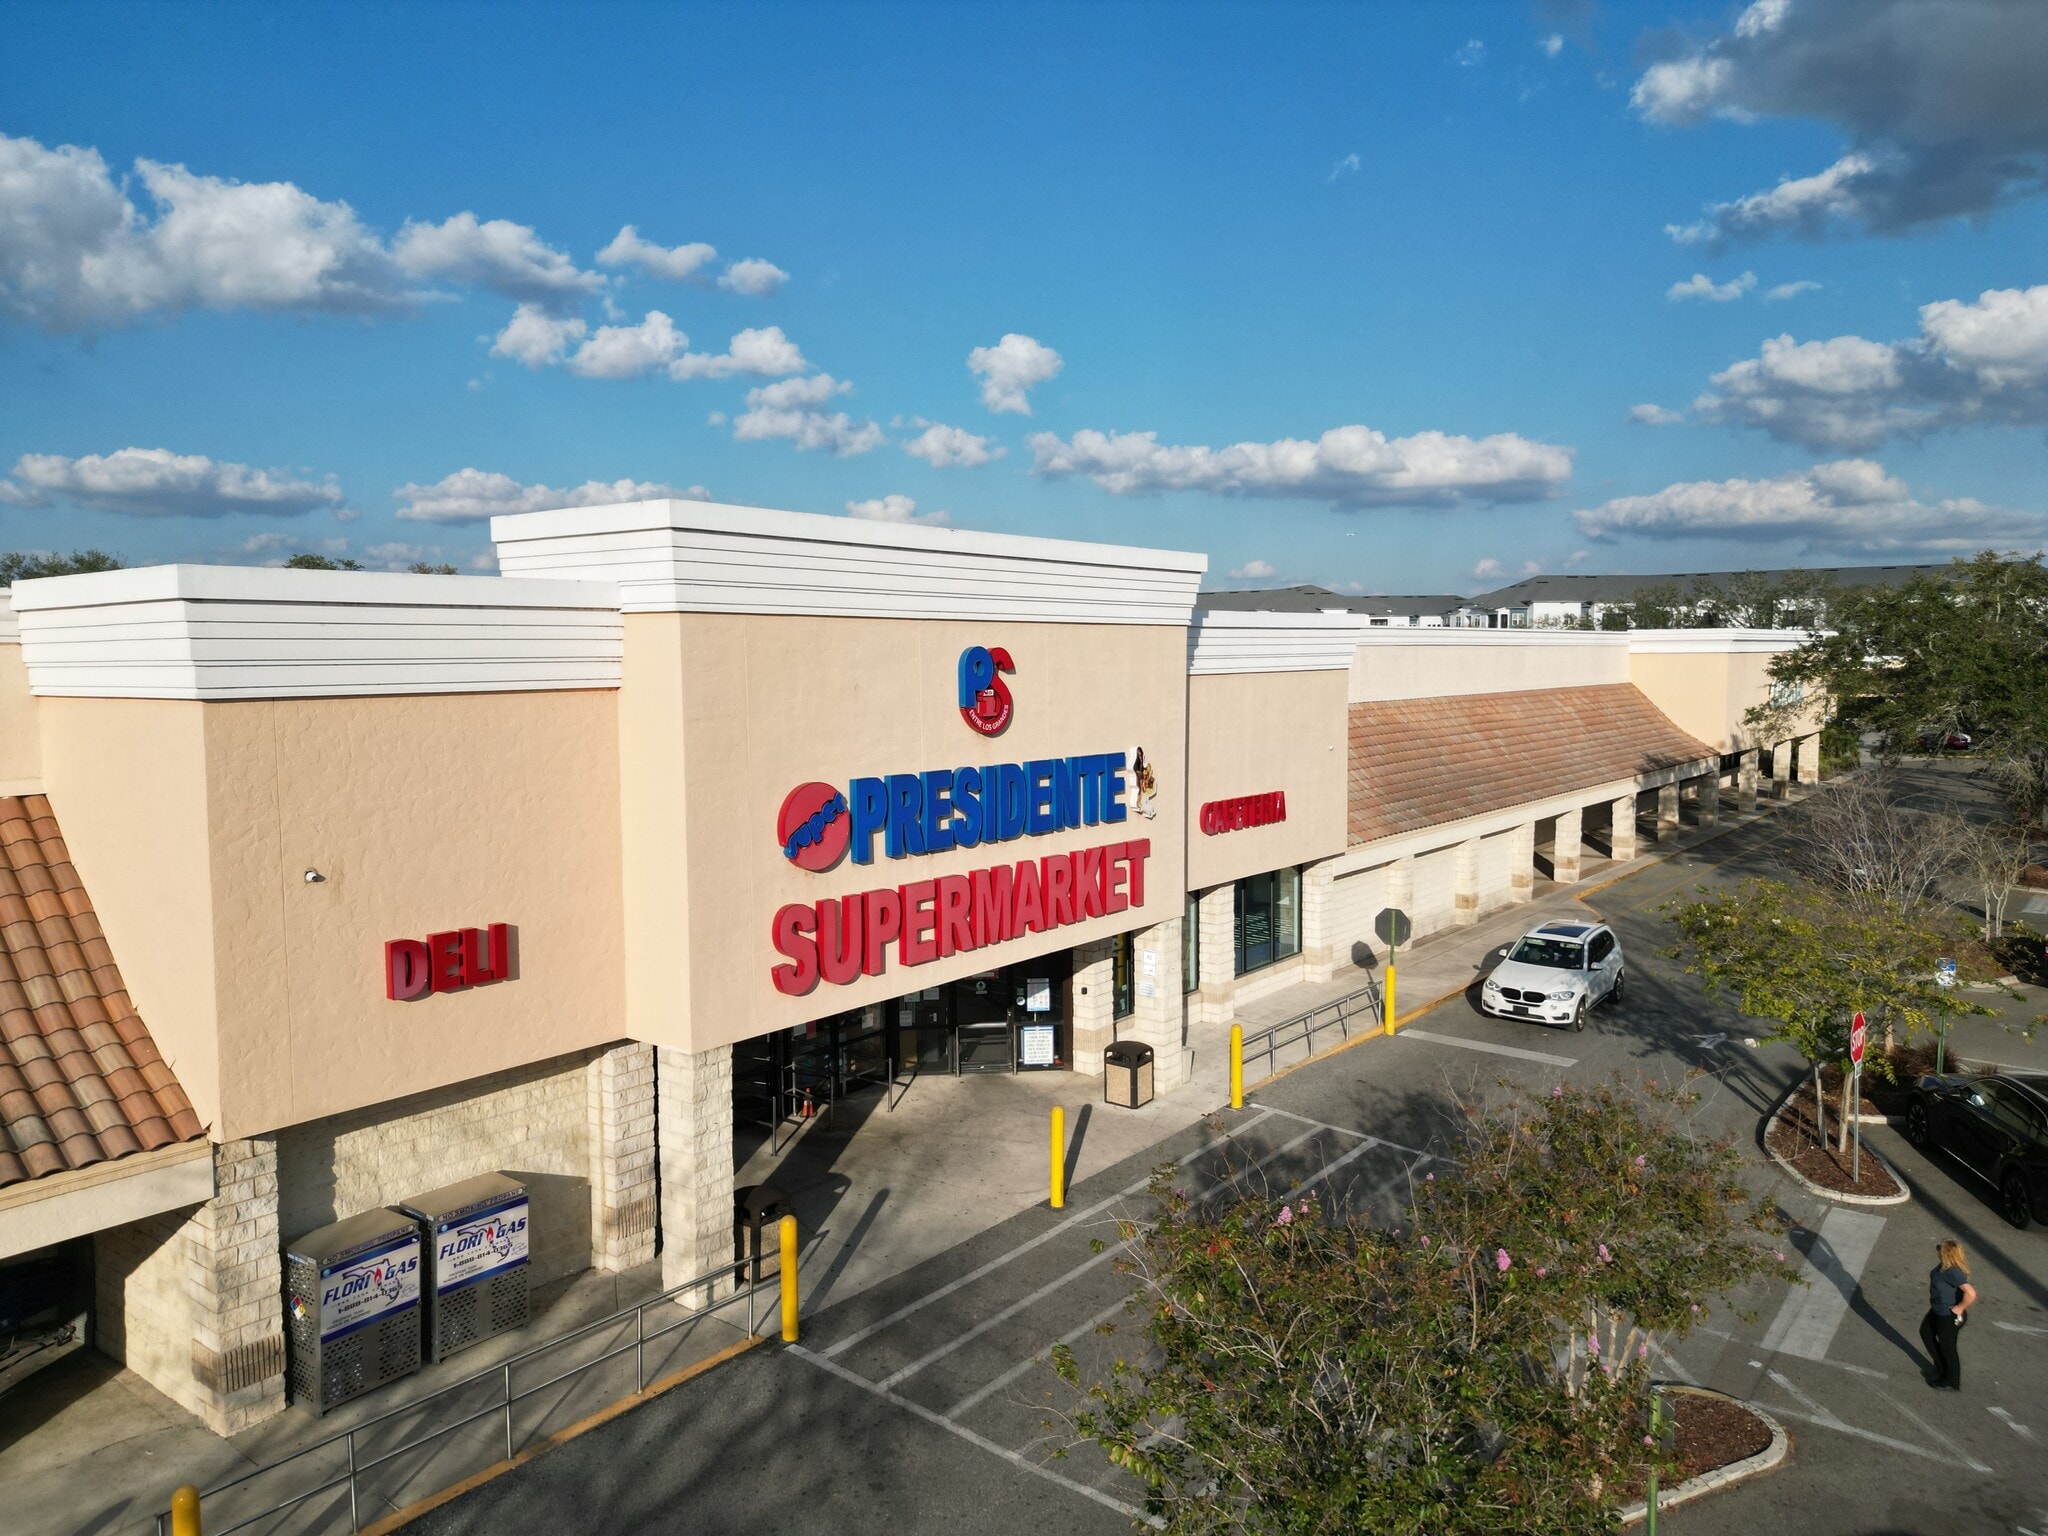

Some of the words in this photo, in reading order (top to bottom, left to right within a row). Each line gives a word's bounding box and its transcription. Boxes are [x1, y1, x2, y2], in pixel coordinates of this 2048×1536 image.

[969, 709, 982, 728] ENTRE
[982, 722, 993, 731] LOS
[992, 704, 1009, 730] GRANDES
[849, 752, 1127, 864] PRESIDENTE
[1199, 790, 1285, 836] CAFETERIA
[772, 838, 1150, 995] SUPERMARKET
[384, 921, 508, 1001] DELI
[1852, 1025, 1864, 1052] STOP
[439, 1232, 484, 1260] FLORI
[496, 1217, 527, 1239] GAS
[323, 1275, 371, 1306] FLORI
[385, 1256, 418, 1281] GAS
